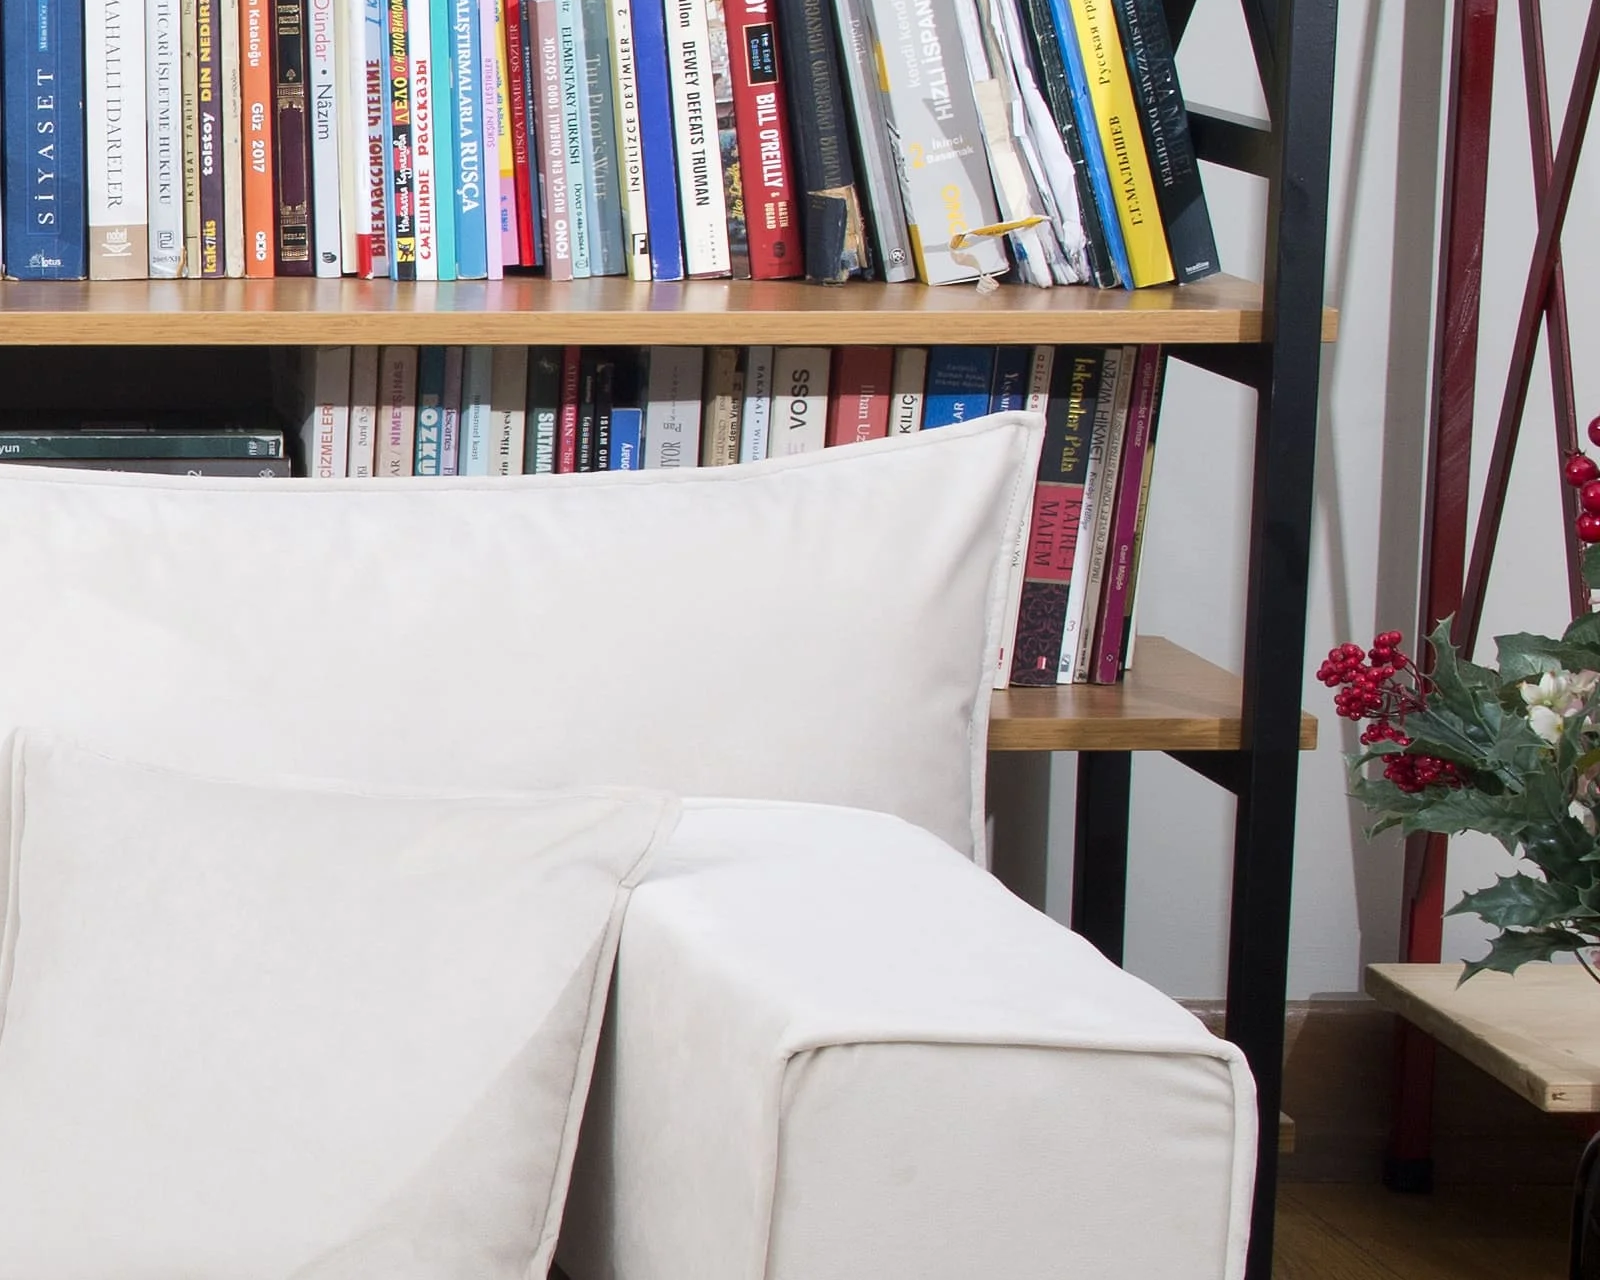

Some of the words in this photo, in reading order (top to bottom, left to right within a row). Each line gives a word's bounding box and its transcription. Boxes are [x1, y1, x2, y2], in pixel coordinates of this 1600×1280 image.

[246, 9, 262, 67] Kataloğu
[682, 41, 699, 86] DEWEY
[561, 26, 579, 108] ELEMENTARY
[250, 102, 266, 131] Güz
[316, 84, 333, 140] Nâzım
[566, 111, 581, 165] TURKISH
[686, 92, 704, 145] DEFEATS
[755, 94, 777, 131] BILL
[36, 69, 55, 225] SİYASET
[252, 140, 266, 173] 2017
[1148, 107, 1174, 187] DAUGHTER
[459, 141, 479, 213] RUSÇA
[691, 149, 710, 206] TRUMAN
[789, 369, 808, 430] VOSS
[444, 407, 455, 451] descartes
[1034, 500, 1059, 567] MATEM
